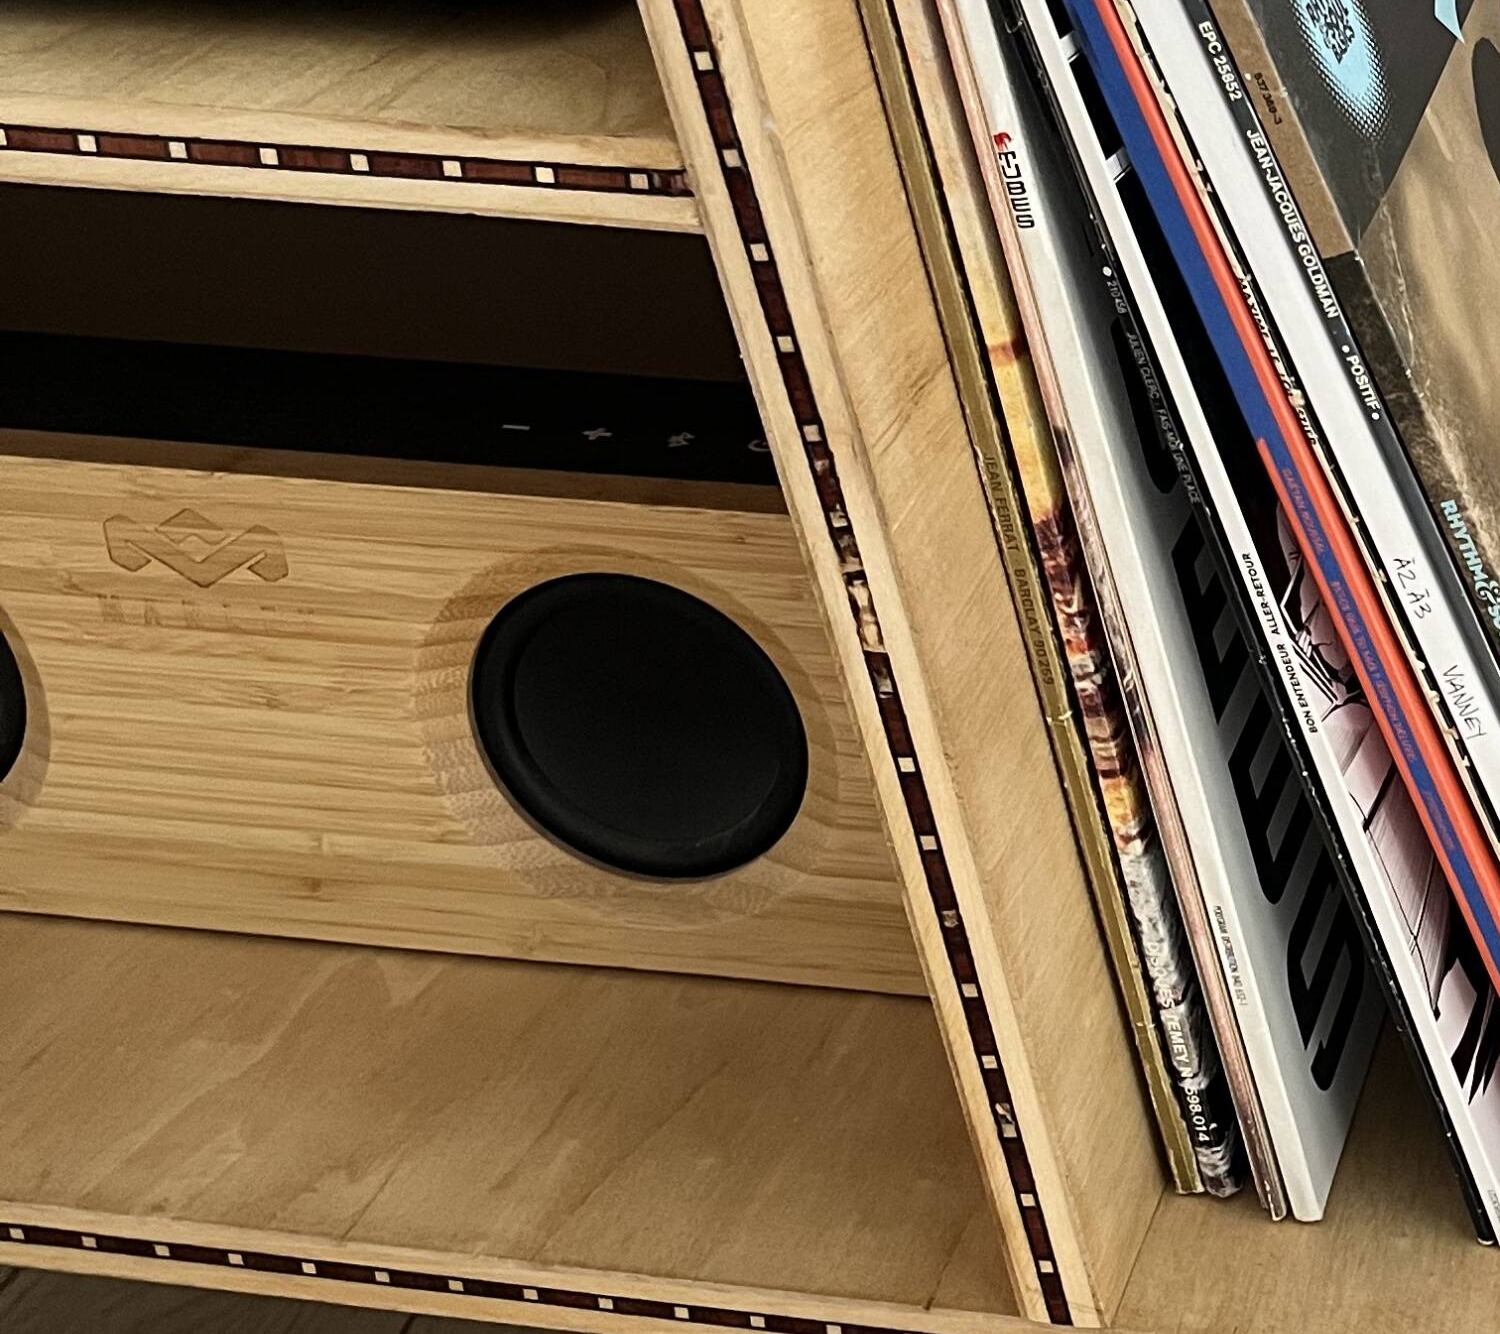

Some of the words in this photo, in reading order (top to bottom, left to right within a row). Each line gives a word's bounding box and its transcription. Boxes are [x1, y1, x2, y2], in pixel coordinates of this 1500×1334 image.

[1199, 21, 1222, 54] EPC
[1213, 52, 1243, 102] 25852
[1246, 128, 1306, 248] JEAN-JACQUES
[1298, 243, 1340, 319] GOLDMAN
[1346, 354, 1381, 410] POSITIF
[1124, 330, 1146, 366] JULIEN
[1138, 365, 1159, 400] CLERC
[1179, 473, 1200, 505] PLACE
[982, 453, 1002, 493] JEAN
[994, 496, 1020, 552] FERRAT
[1012, 567, 1041, 634] BARCLAY
[1240, 551, 1280, 636] ALLER-RETOUR
[1275, 642, 1308, 709] ENTENDEUR
[1302, 709, 1318, 734] BON
[1144, 940, 1175, 1008] DISQUES
